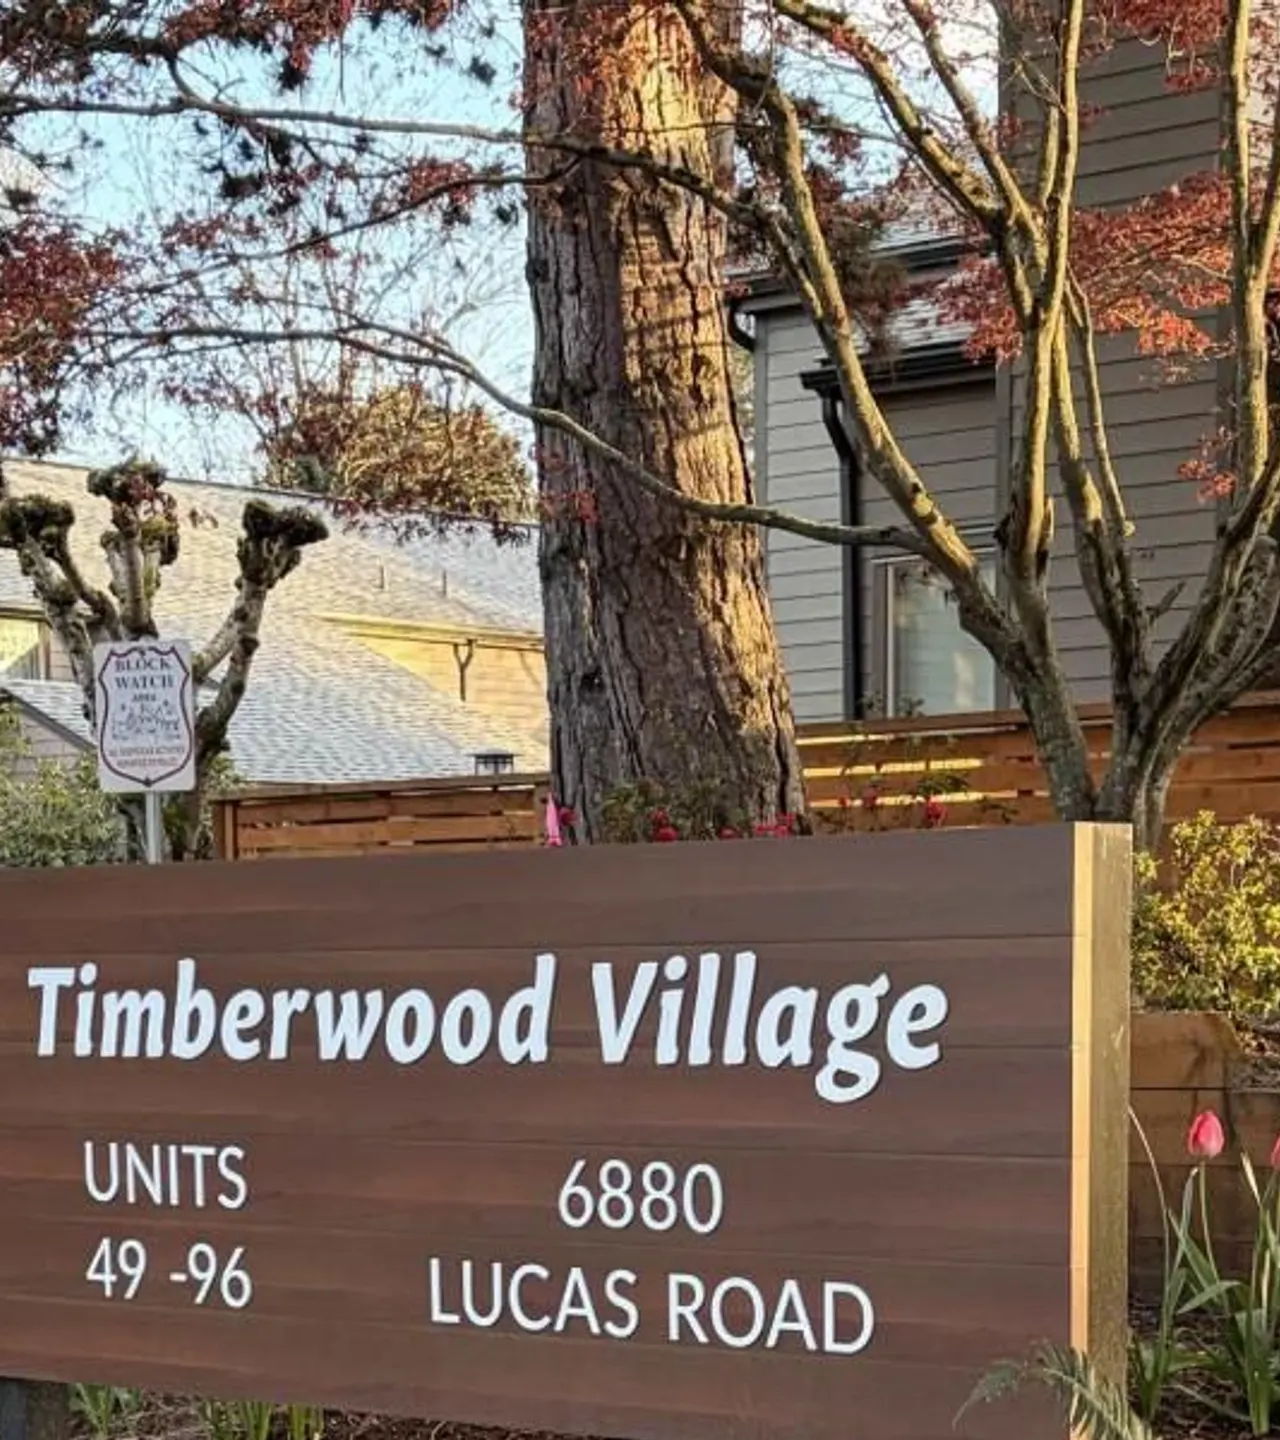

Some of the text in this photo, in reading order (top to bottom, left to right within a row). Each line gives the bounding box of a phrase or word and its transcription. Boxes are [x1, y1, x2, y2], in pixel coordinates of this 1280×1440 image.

[114, 656, 172, 672] BLOCK
[114, 674, 174, 690] WATCH
[26, 949, 949, 1104] Timberwood Village
[83, 1140, 247, 1210] UNITS
[557, 1158, 724, 1235] 6880
[85, 1237, 148, 1300] 49
[429, 1257, 875, 1355] LUCAS ROAD
